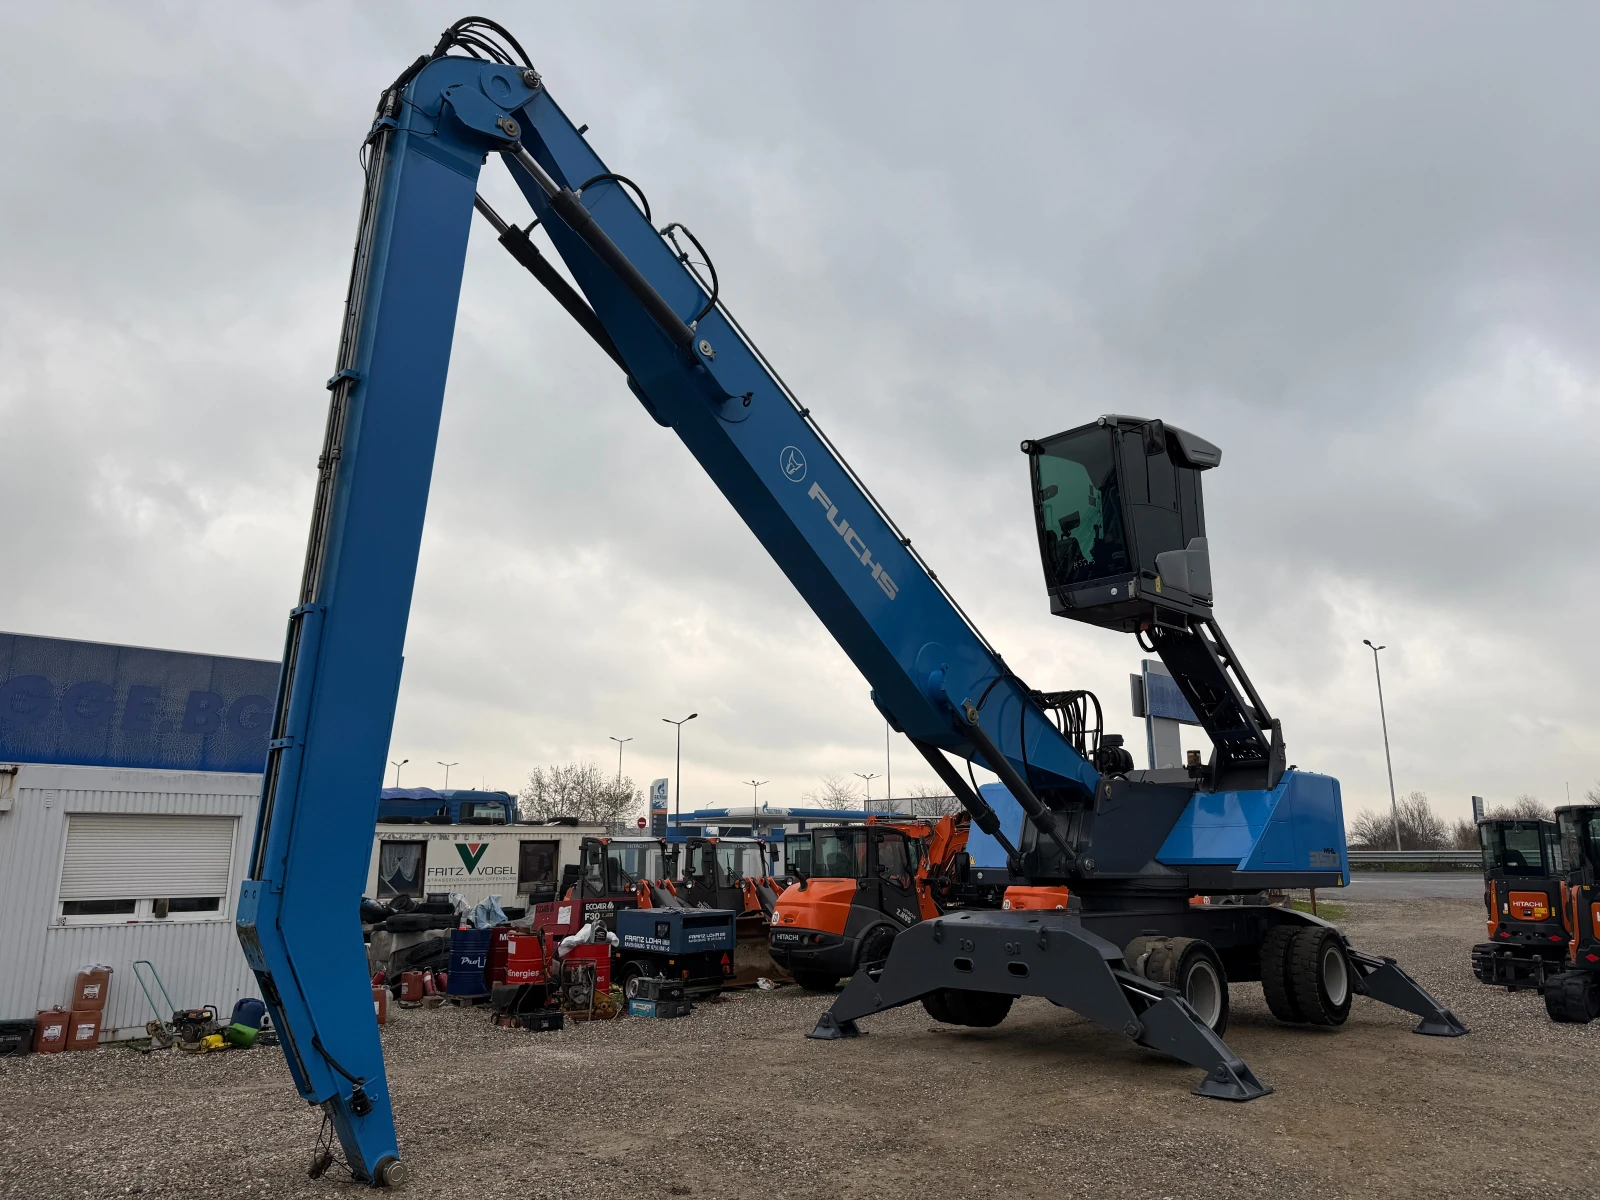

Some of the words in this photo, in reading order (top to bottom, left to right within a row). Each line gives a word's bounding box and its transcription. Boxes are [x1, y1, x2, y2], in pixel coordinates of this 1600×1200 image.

[808, 481, 899, 600] FUCHS
[1309, 851, 1340, 868] 350
[427, 867, 464, 876] FRITZ
[477, 866, 517, 876] VOGEL
[585, 902, 607, 911] ECOAIR
[1512, 900, 1543, 908] HITACHI
[584, 912, 600, 921] F30
[624, 934, 645, 943] FRANZ
[776, 933, 799, 941] HITACHI
[507, 970, 540, 979] Energies
